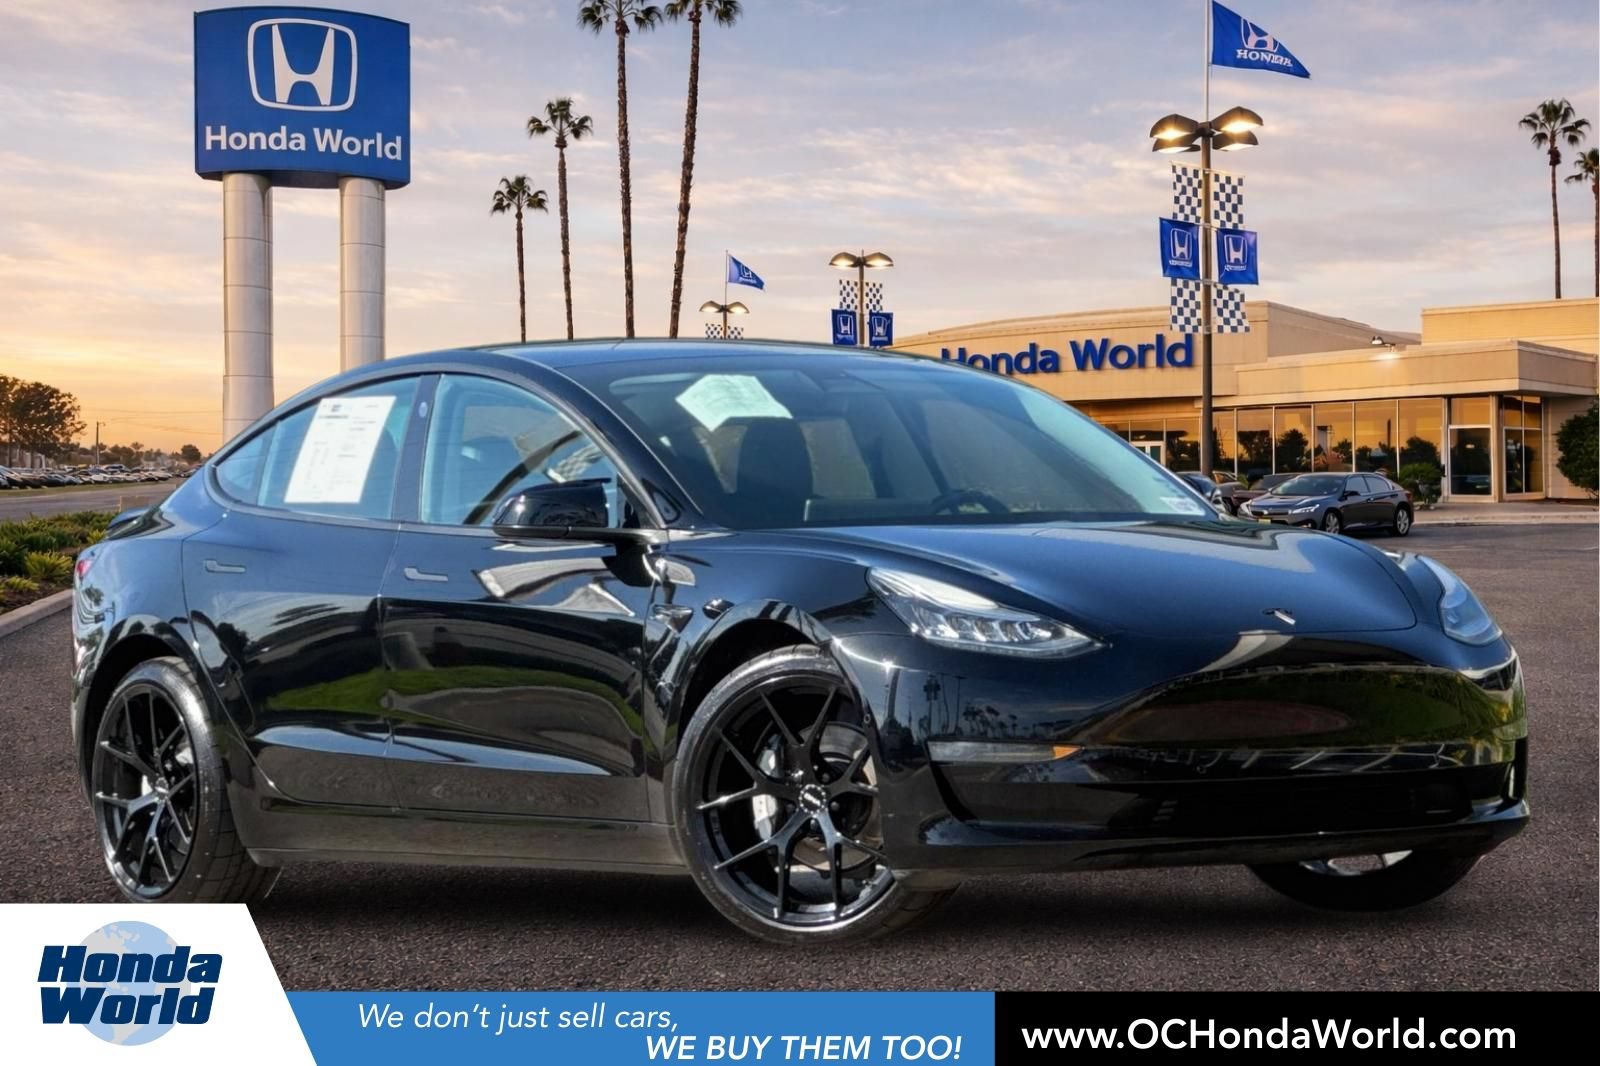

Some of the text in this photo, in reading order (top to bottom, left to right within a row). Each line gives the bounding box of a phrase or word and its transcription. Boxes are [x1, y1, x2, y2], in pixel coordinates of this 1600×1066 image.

[205, 125, 402, 160] Honda World
[1069, 333, 1194, 371] World
